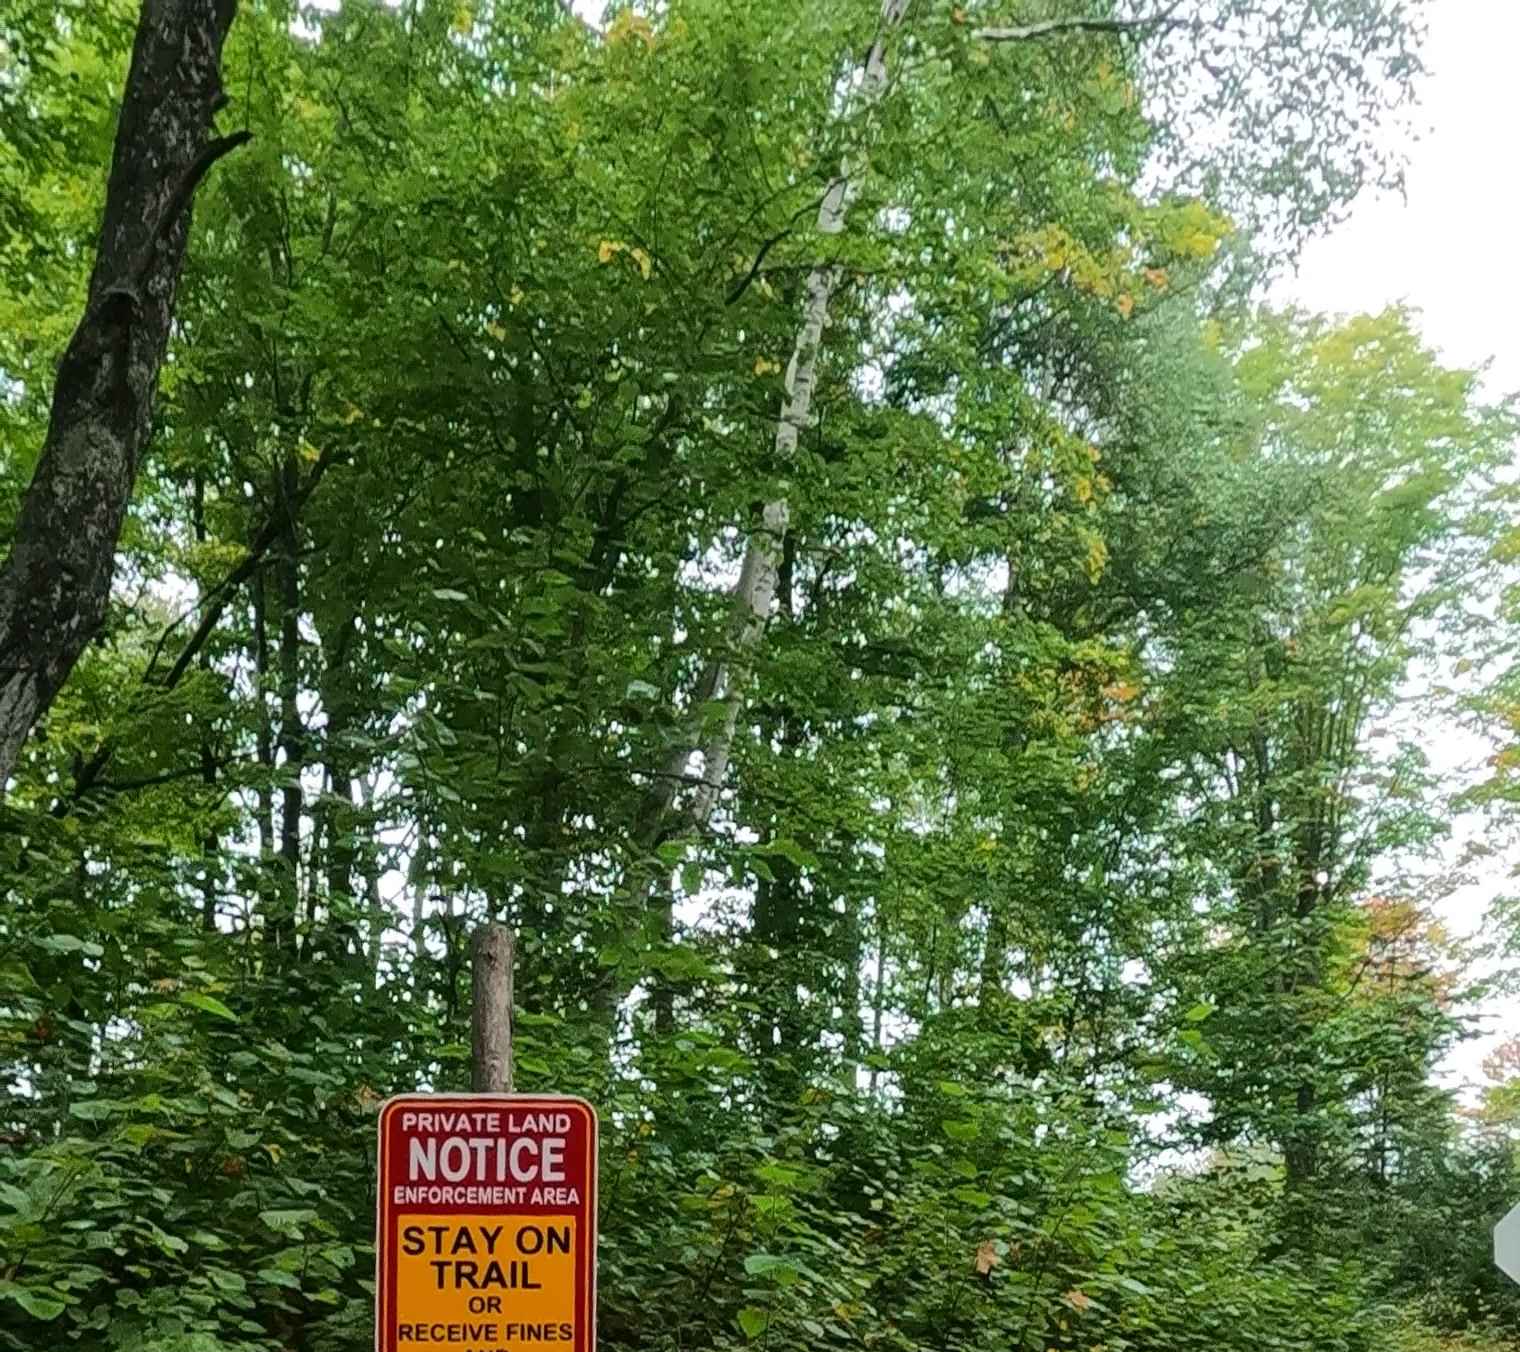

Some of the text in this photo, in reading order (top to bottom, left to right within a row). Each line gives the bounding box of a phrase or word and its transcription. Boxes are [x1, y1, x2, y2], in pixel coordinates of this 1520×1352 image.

[402, 1113, 571, 1133] PRIVATE LAND
[409, 1137, 566, 1182] NOTICE
[394, 1186, 580, 1205] ENFORCEMENT AREA
[402, 1226, 571, 1255] STAY ON
[430, 1261, 542, 1290] TRAIL
[468, 1296, 502, 1314] OR
[399, 1323, 573, 1341] RECEIVE FINES
